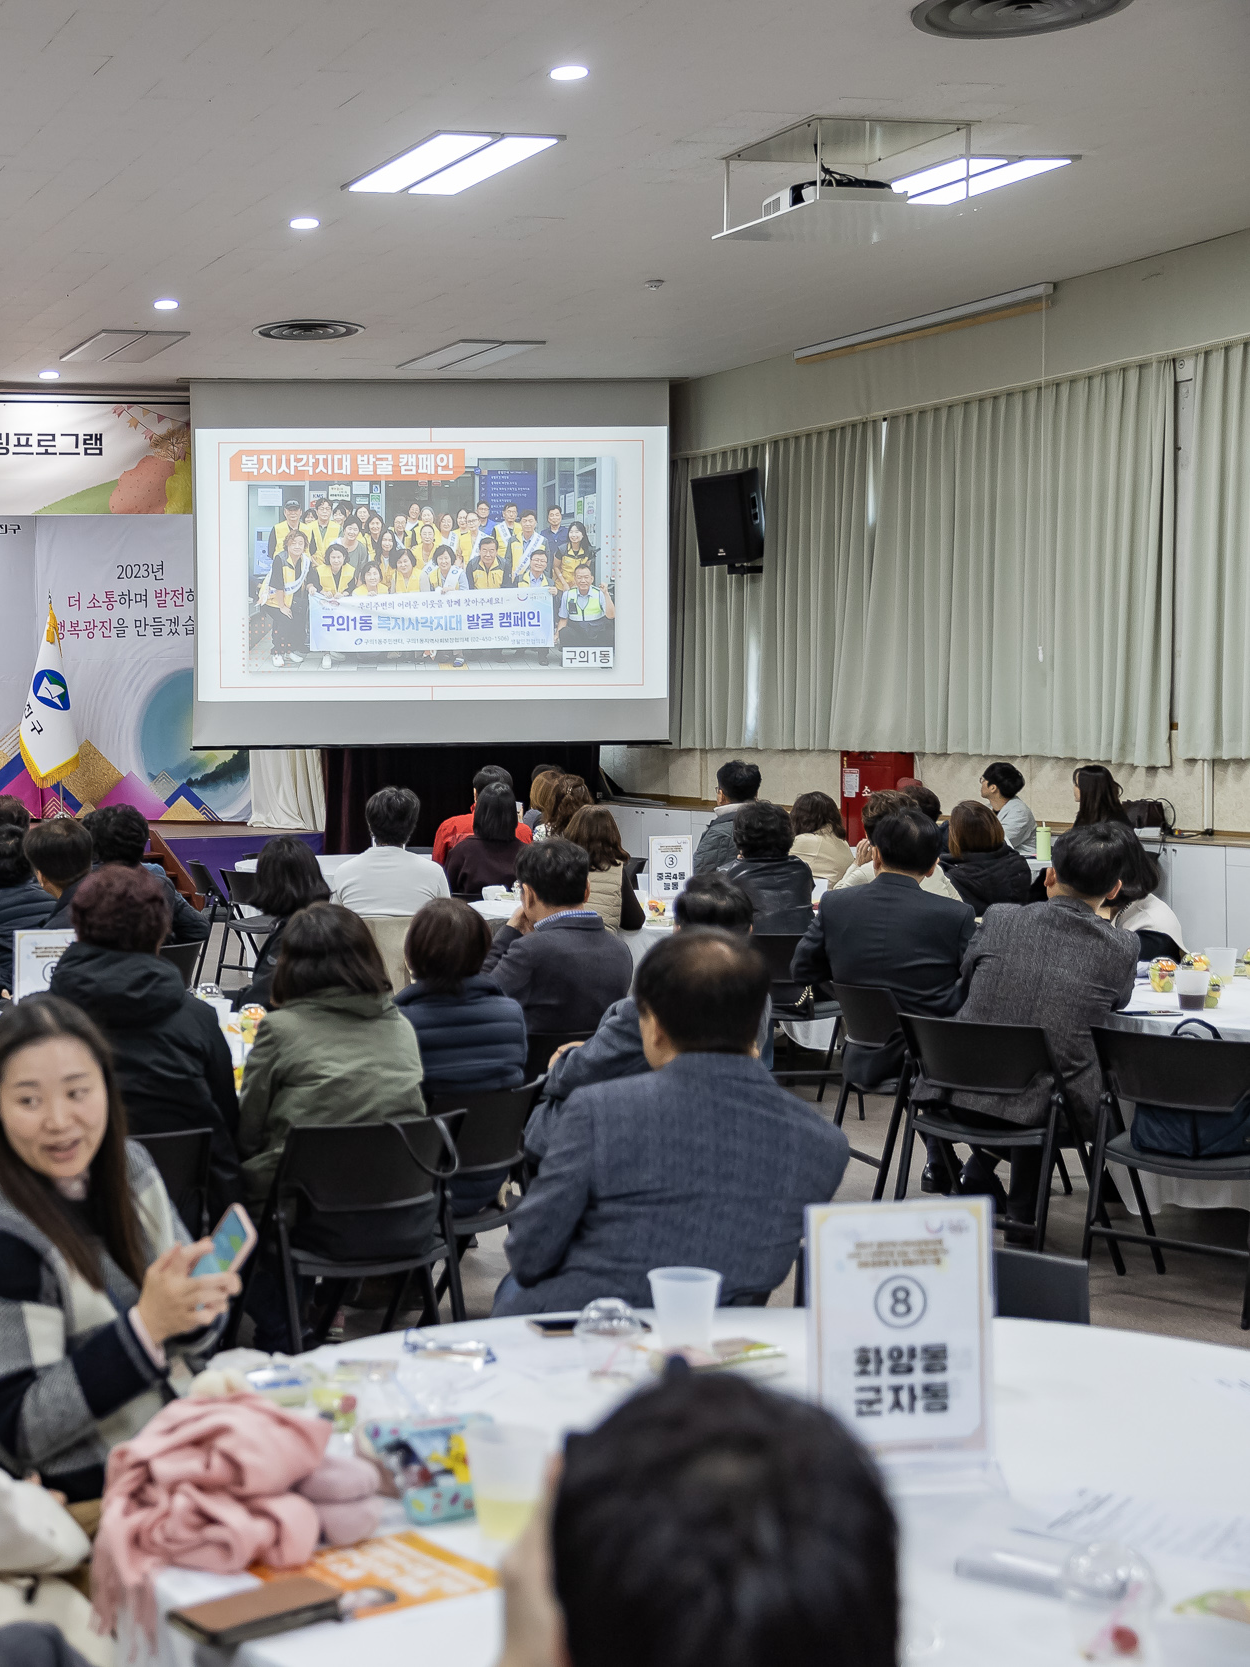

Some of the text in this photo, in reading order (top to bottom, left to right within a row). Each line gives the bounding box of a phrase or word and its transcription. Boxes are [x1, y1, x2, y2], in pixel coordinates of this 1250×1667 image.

[240, 453, 454, 476] 복지사각지대 발굴 캠페인
[116, 560, 165, 581] 2023년
[67, 591, 81, 612] 더
[86, 588, 149, 612] 소통하며
[321, 610, 541, 632] 구의1동 복지사각지대 발굴 캠페인
[565, 650, 611, 664] 구의1동
[668, 856, 675, 866] 3
[656, 871, 686, 881] 중곡4동
[889, 1285, 913, 1318] 8
[853, 1342, 949, 1377] 화양동
[854, 1381, 950, 1418] 군자동
